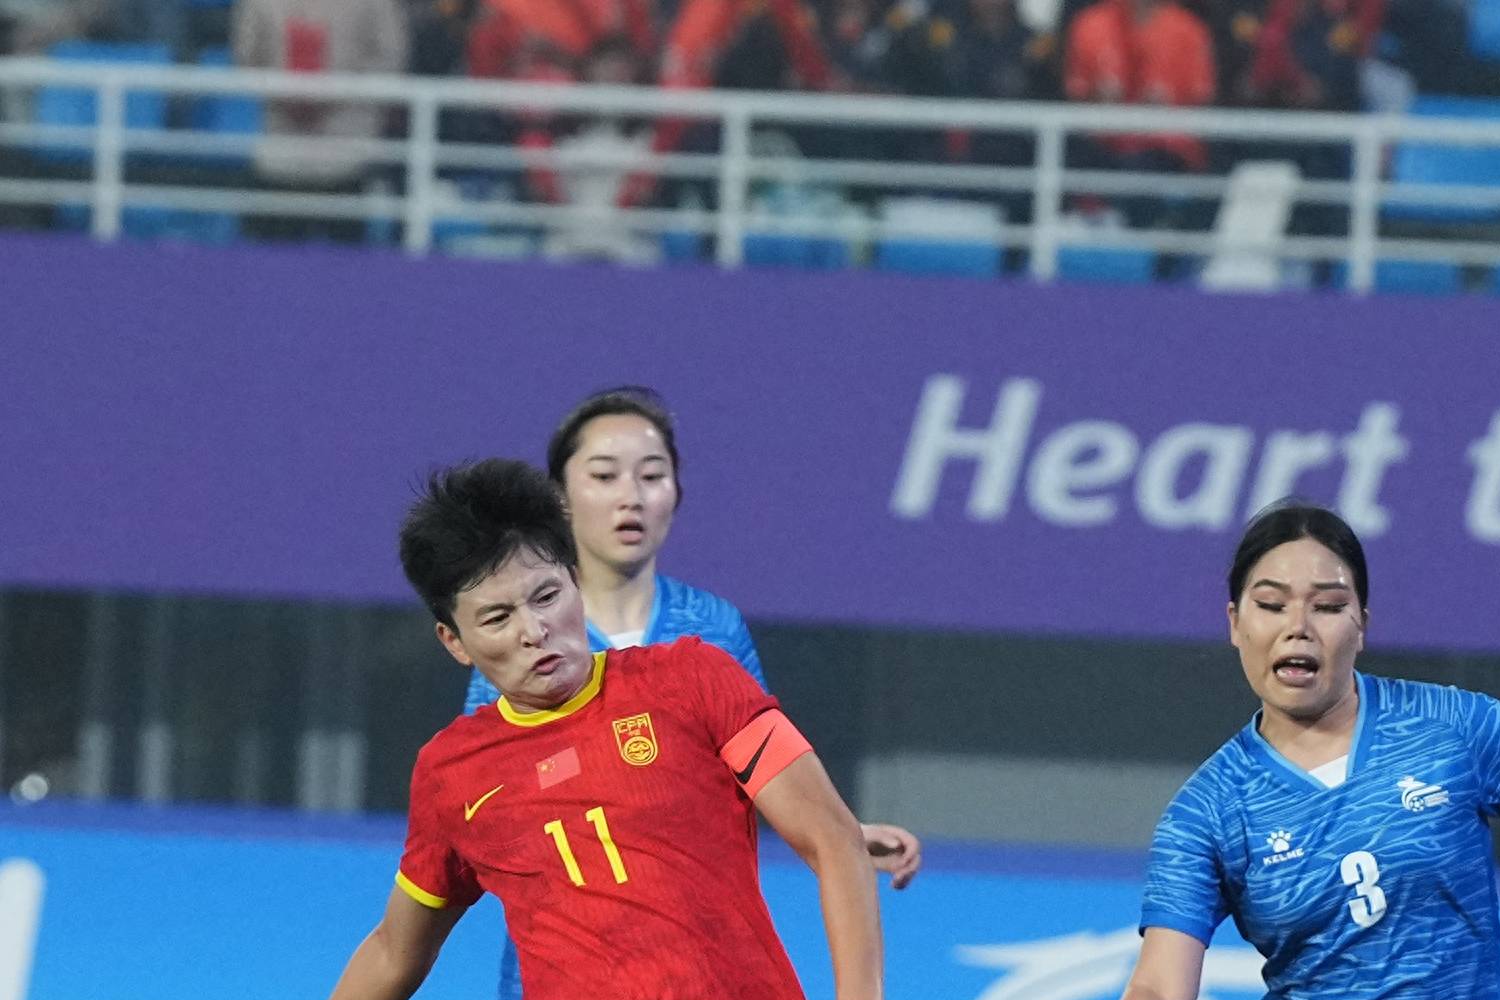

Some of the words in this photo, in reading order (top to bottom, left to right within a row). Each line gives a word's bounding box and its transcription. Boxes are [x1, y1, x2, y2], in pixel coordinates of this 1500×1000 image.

[889, 372, 1409, 539] Heart
[543, 806, 629, 887] 11
[1262, 847, 1305, 866] KELME
[1340, 850, 1387, 928] 3
